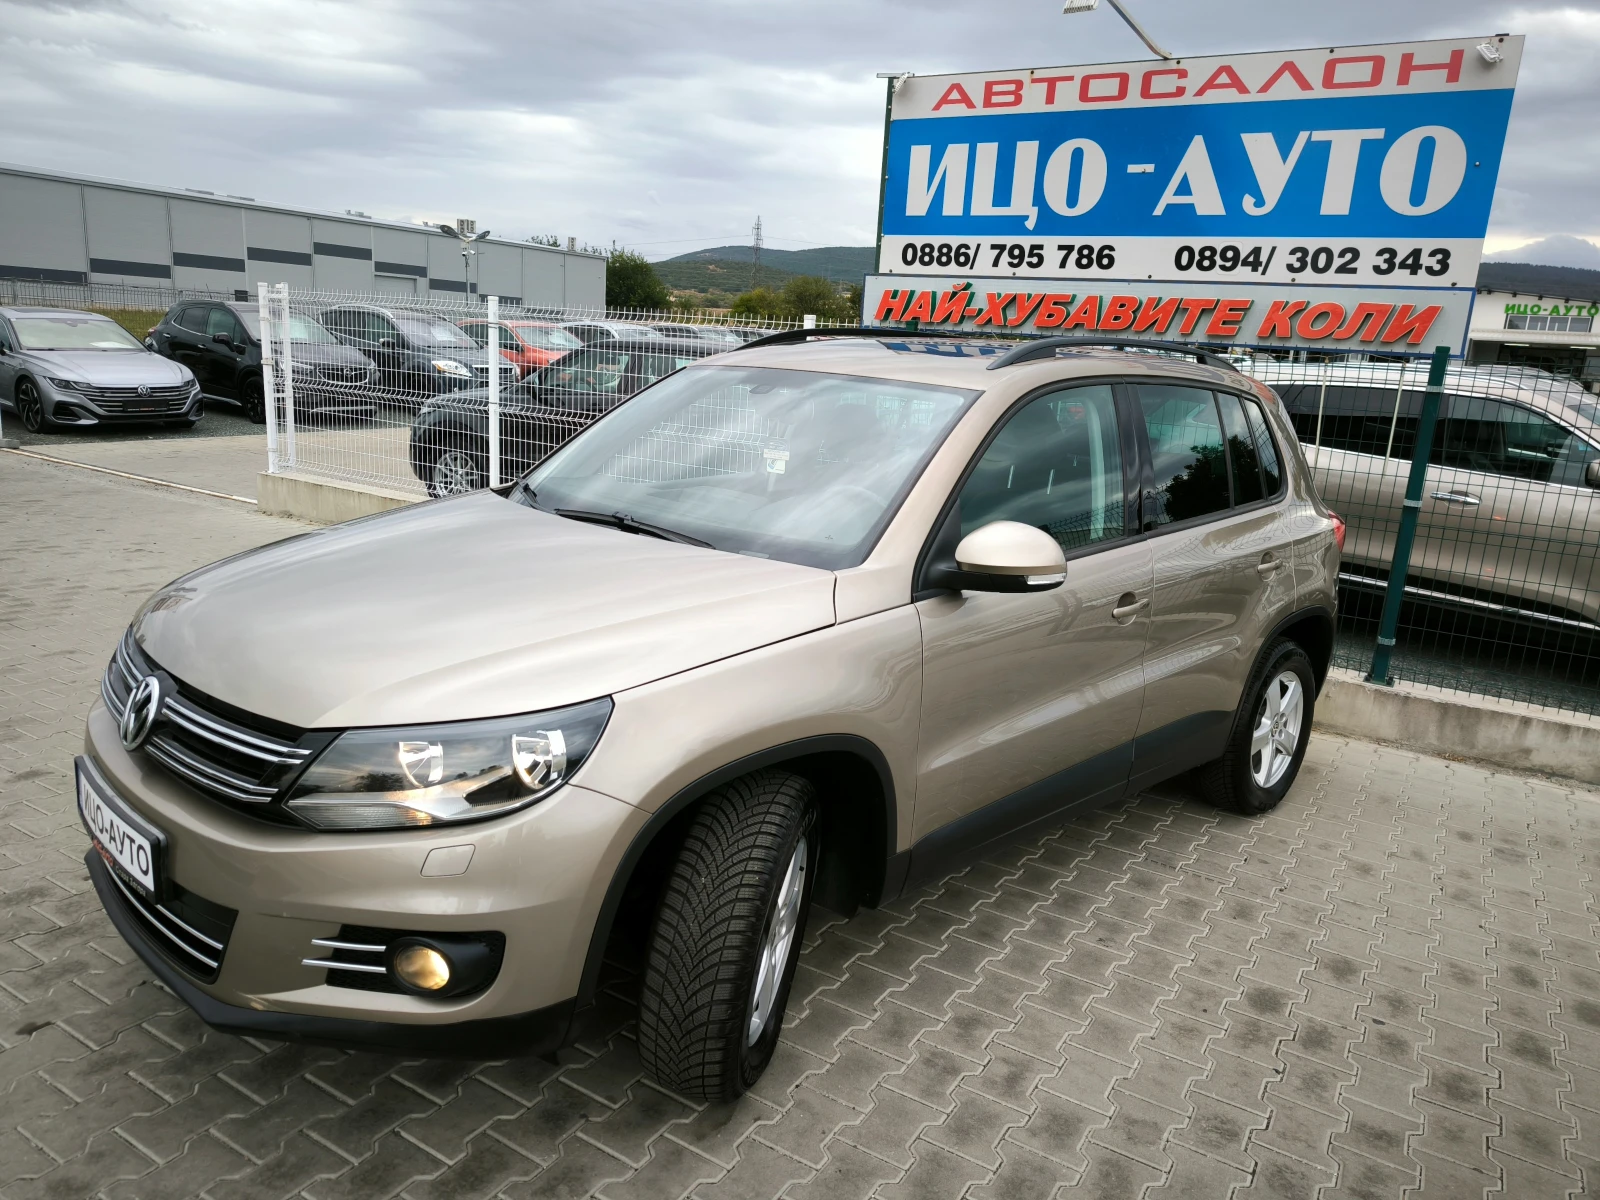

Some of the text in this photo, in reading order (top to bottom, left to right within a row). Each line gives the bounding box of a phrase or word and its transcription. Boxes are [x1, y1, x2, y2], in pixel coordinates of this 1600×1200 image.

[931, 50, 1464, 112] АВТОСАЛОН
[901, 242, 1116, 270] 0886/ 795 786
[1174, 245, 1452, 277] 0894/ 302 343
[873, 282, 1443, 345] НАЙ-ХУБАВИТЕ КОЛИ
[1504, 303, 1599, 318] ИЦО-АУТО
[83, 783, 150, 877] ИЦО-АУТО
